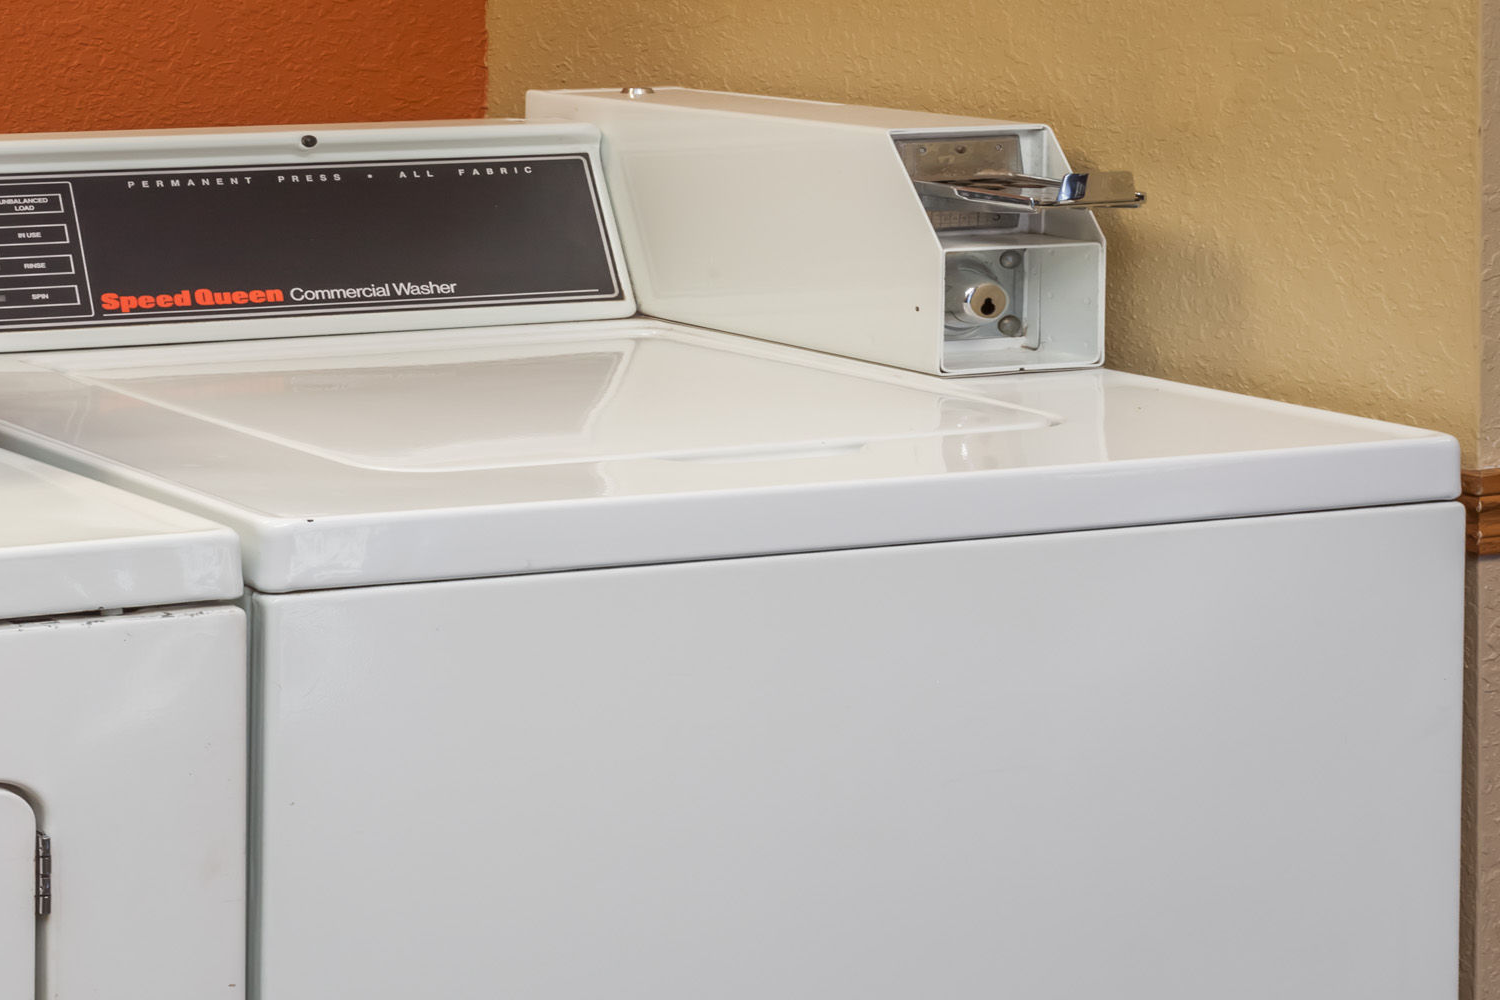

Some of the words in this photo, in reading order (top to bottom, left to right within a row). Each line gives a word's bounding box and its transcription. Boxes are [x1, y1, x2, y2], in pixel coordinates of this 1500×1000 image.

[127, 177, 253, 189] PERMANENT
[278, 173, 341, 183] PRESS
[399, 170, 434, 179] ALL
[458, 166, 533, 177] FABRIC
[23, 262, 46, 270] RINSE
[101, 290, 192, 312] Speed
[195, 288, 284, 304] Queen
[290, 284, 390, 301] Commercial
[393, 281, 457, 296] Washer
